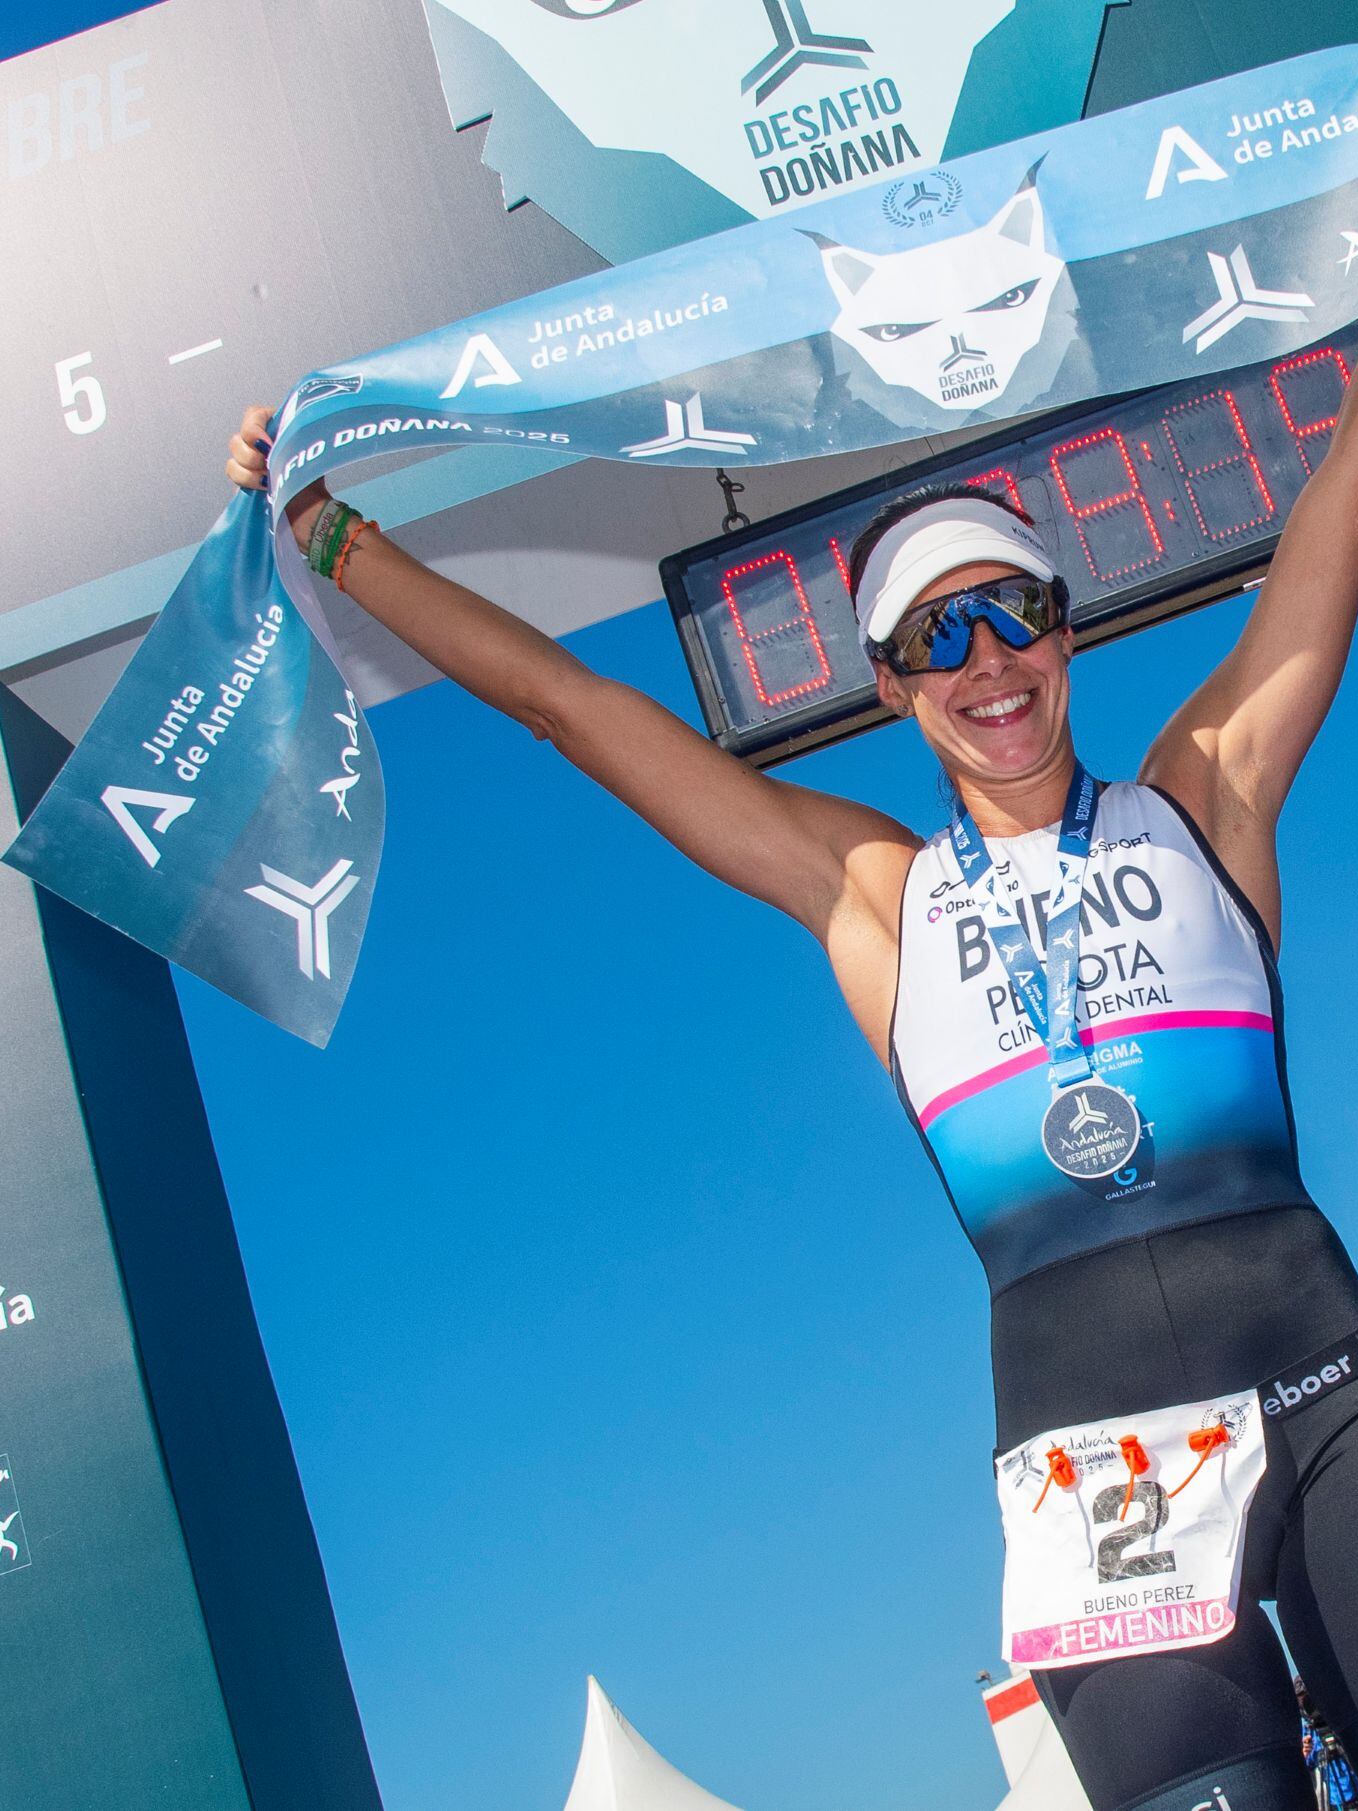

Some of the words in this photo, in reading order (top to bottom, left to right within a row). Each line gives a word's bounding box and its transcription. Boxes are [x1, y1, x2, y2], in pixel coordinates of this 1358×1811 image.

[742, 76, 903, 160] DESAFIO
[1226, 97, 1316, 139] Junta
[759, 122, 921, 206] DOÑANA
[1233, 138, 1275, 165] de
[528, 303, 615, 344] Junta
[530, 341, 574, 370] de
[578, 291, 729, 355] Andalucía
[55, 351, 107, 436] 5
[939, 363, 995, 388] DESAFIO
[942, 377, 999, 402] DOÑANA
[333, 418, 472, 448] DOÑANA
[481, 427, 570, 444] 2025
[177, 744, 210, 782] de
[198, 603, 285, 745] Andalucía
[141, 685, 205, 765] Junta
[1085, 984, 1173, 1019] DENTAL
[1060, 1122, 1128, 1153] Andalucía
[1066, 1147, 1098, 1165] DESAFIO
[1097, 1137, 1128, 1156] DOÑANA
[1105, 1180, 1156, 1200] GALLASTEGUI
[1093, 1481, 1176, 1585] 2
[1083, 1590, 1139, 1614] BUENO
[1142, 1584, 1195, 1606] PEREZ
[1060, 1601, 1226, 1655] FEMENINO
